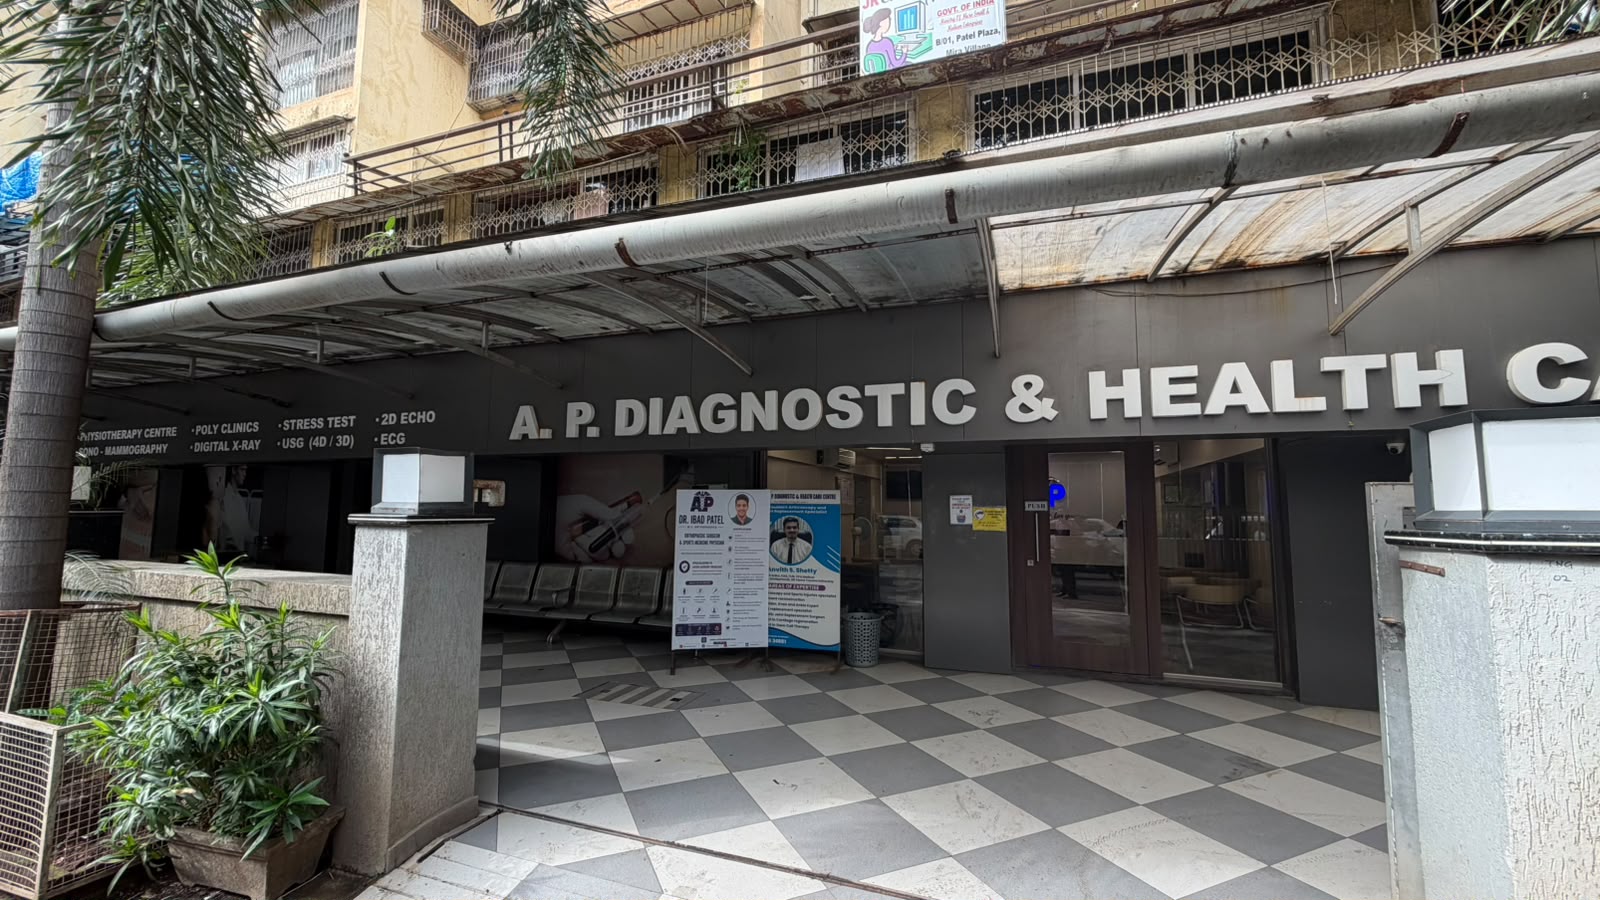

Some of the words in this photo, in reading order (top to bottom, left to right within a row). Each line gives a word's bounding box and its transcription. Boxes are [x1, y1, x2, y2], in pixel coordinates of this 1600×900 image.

[937, 5, 959, 17] GOVT.
[961, 2, 972, 11] OF
[956, 31, 976, 42] Patel
[977, 28, 1001, 38] Plaza,
[508, 404, 552, 441] A.
[565, 401, 600, 439] P.
[614, 378, 977, 437] DIAGNOSTIC
[1004, 373, 1059, 423] &
[1088, 348, 1469, 421] HEALTH
[1506, 341, 1600, 406] C
[283, 417, 324, 431] STRESS
[327, 415, 356, 429] TEST
[381, 412, 397, 426] 2D
[400, 410, 436, 425] ECHO
[144, 426, 178, 438] CENTRE
[195, 423, 220, 436] POLY
[221, 421, 260, 435] CLINICS
[193, 440, 230, 453] DIGITAL
[231, 438, 262, 452] X-RAY
[282, 436, 304, 449] USG
[309, 436, 327, 450] (4D
[335, 434, 355, 450] 3D)
[380, 432, 406, 446] ECG
[104, 443, 169, 456] MAMMOGRAPHY
[679, 515, 689, 525] DR.
[706, 515, 725, 525] PATEL
